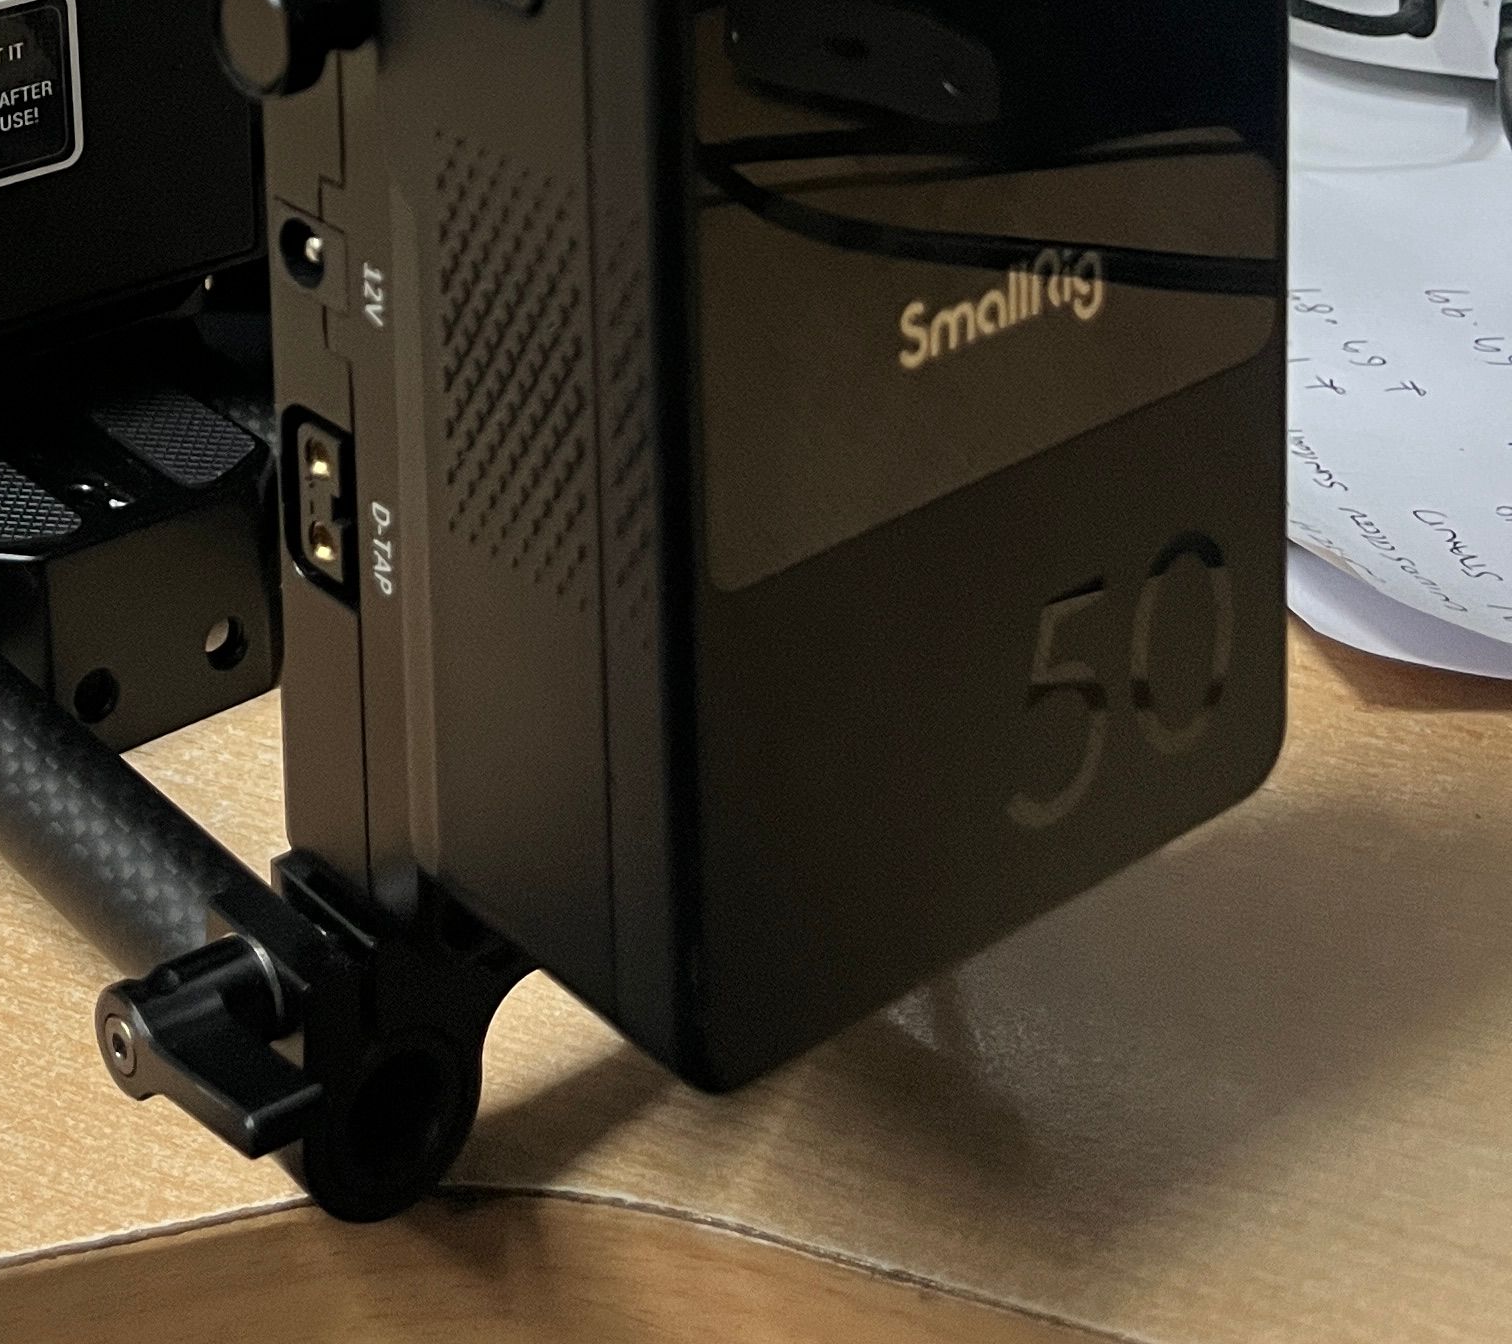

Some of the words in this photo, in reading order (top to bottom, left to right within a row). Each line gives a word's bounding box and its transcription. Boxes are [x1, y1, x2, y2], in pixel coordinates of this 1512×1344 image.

[8, 43, 24, 62] IT
[0, 107, 39, 132] USE!
[364, 262, 384, 327] 12V
[899, 249, 1103, 369] SmallRig
[372, 501, 392, 595] D-TAP
[1006, 528, 1237, 829] 50
